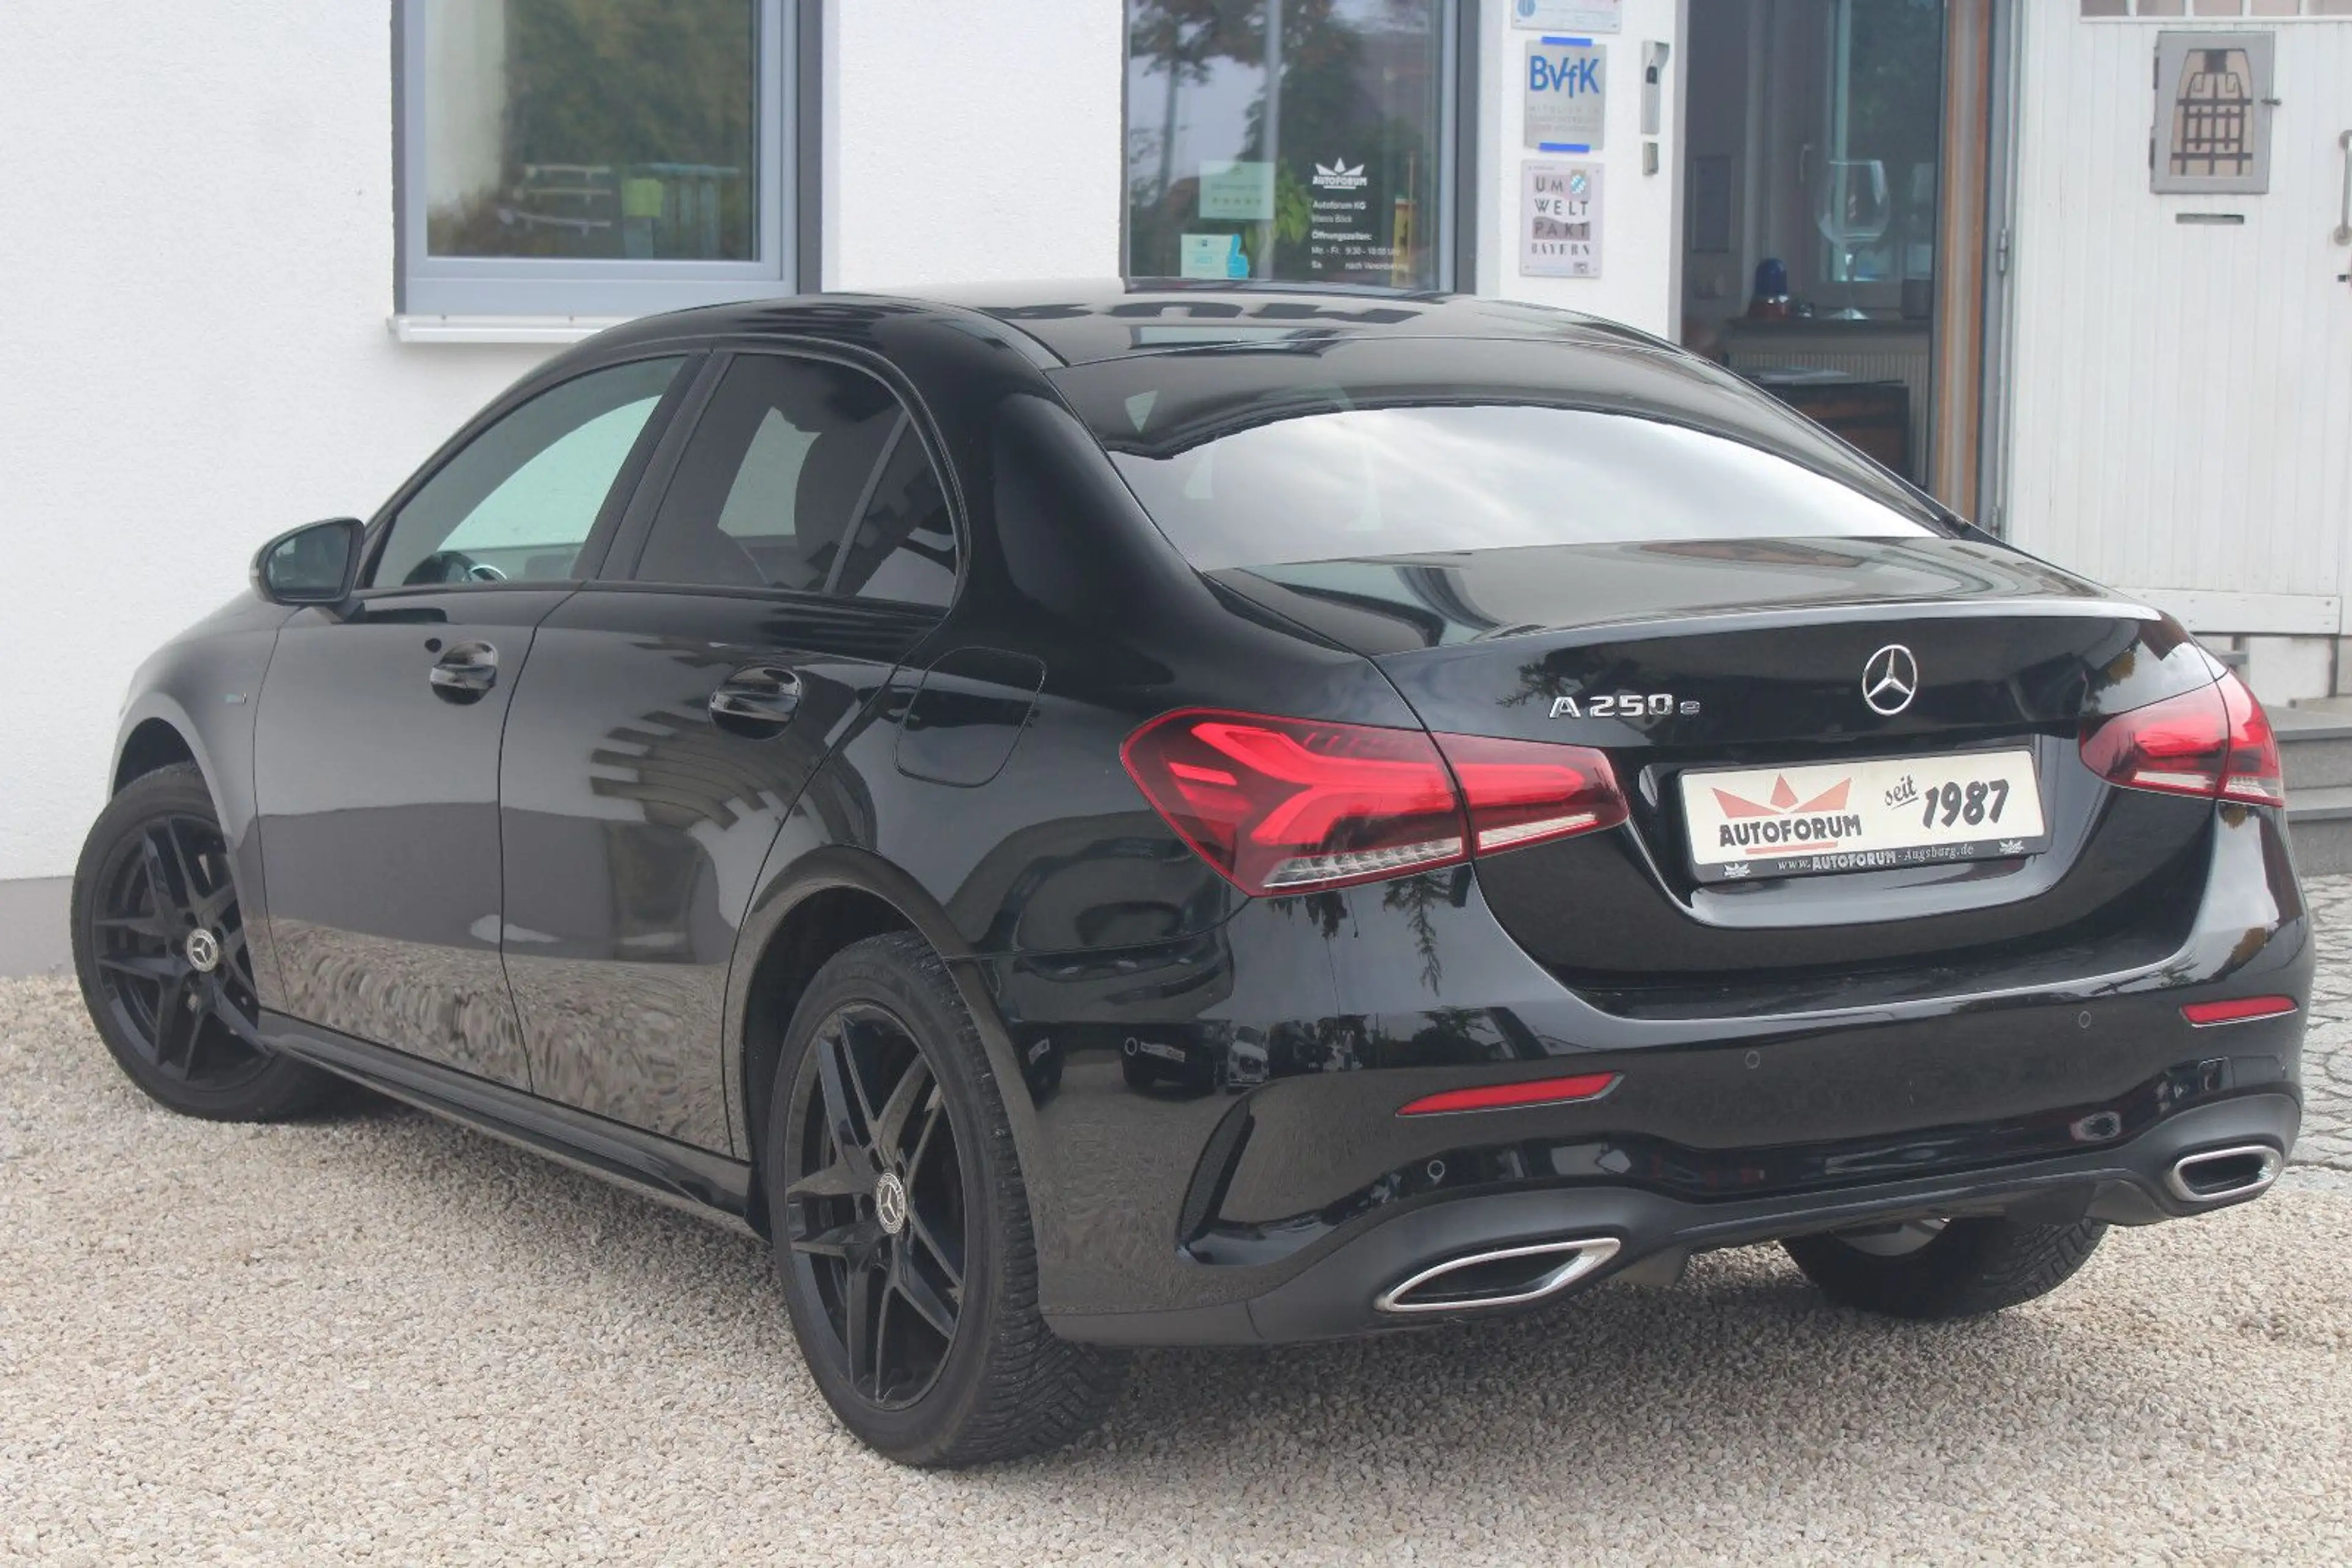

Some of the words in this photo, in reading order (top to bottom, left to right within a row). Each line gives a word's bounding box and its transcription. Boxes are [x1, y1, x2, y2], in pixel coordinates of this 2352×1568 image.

[1313, 176, 1368, 186] AUTOFORUM
[1536, 175, 1563, 192] UM
[1313, 200, 1353, 210] Autoforum
[1534, 198, 1588, 216] WELT
[1534, 222, 1588, 236] PAKT
[1531, 243, 1589, 255] BAYERN
[1549, 696, 1581, 718] A
[1589, 693, 1673, 717] 250
[1884, 775, 1917, 805] seit
[1923, 778, 2009, 829] 1987
[1719, 814, 1863, 848] AUTOFORUM
